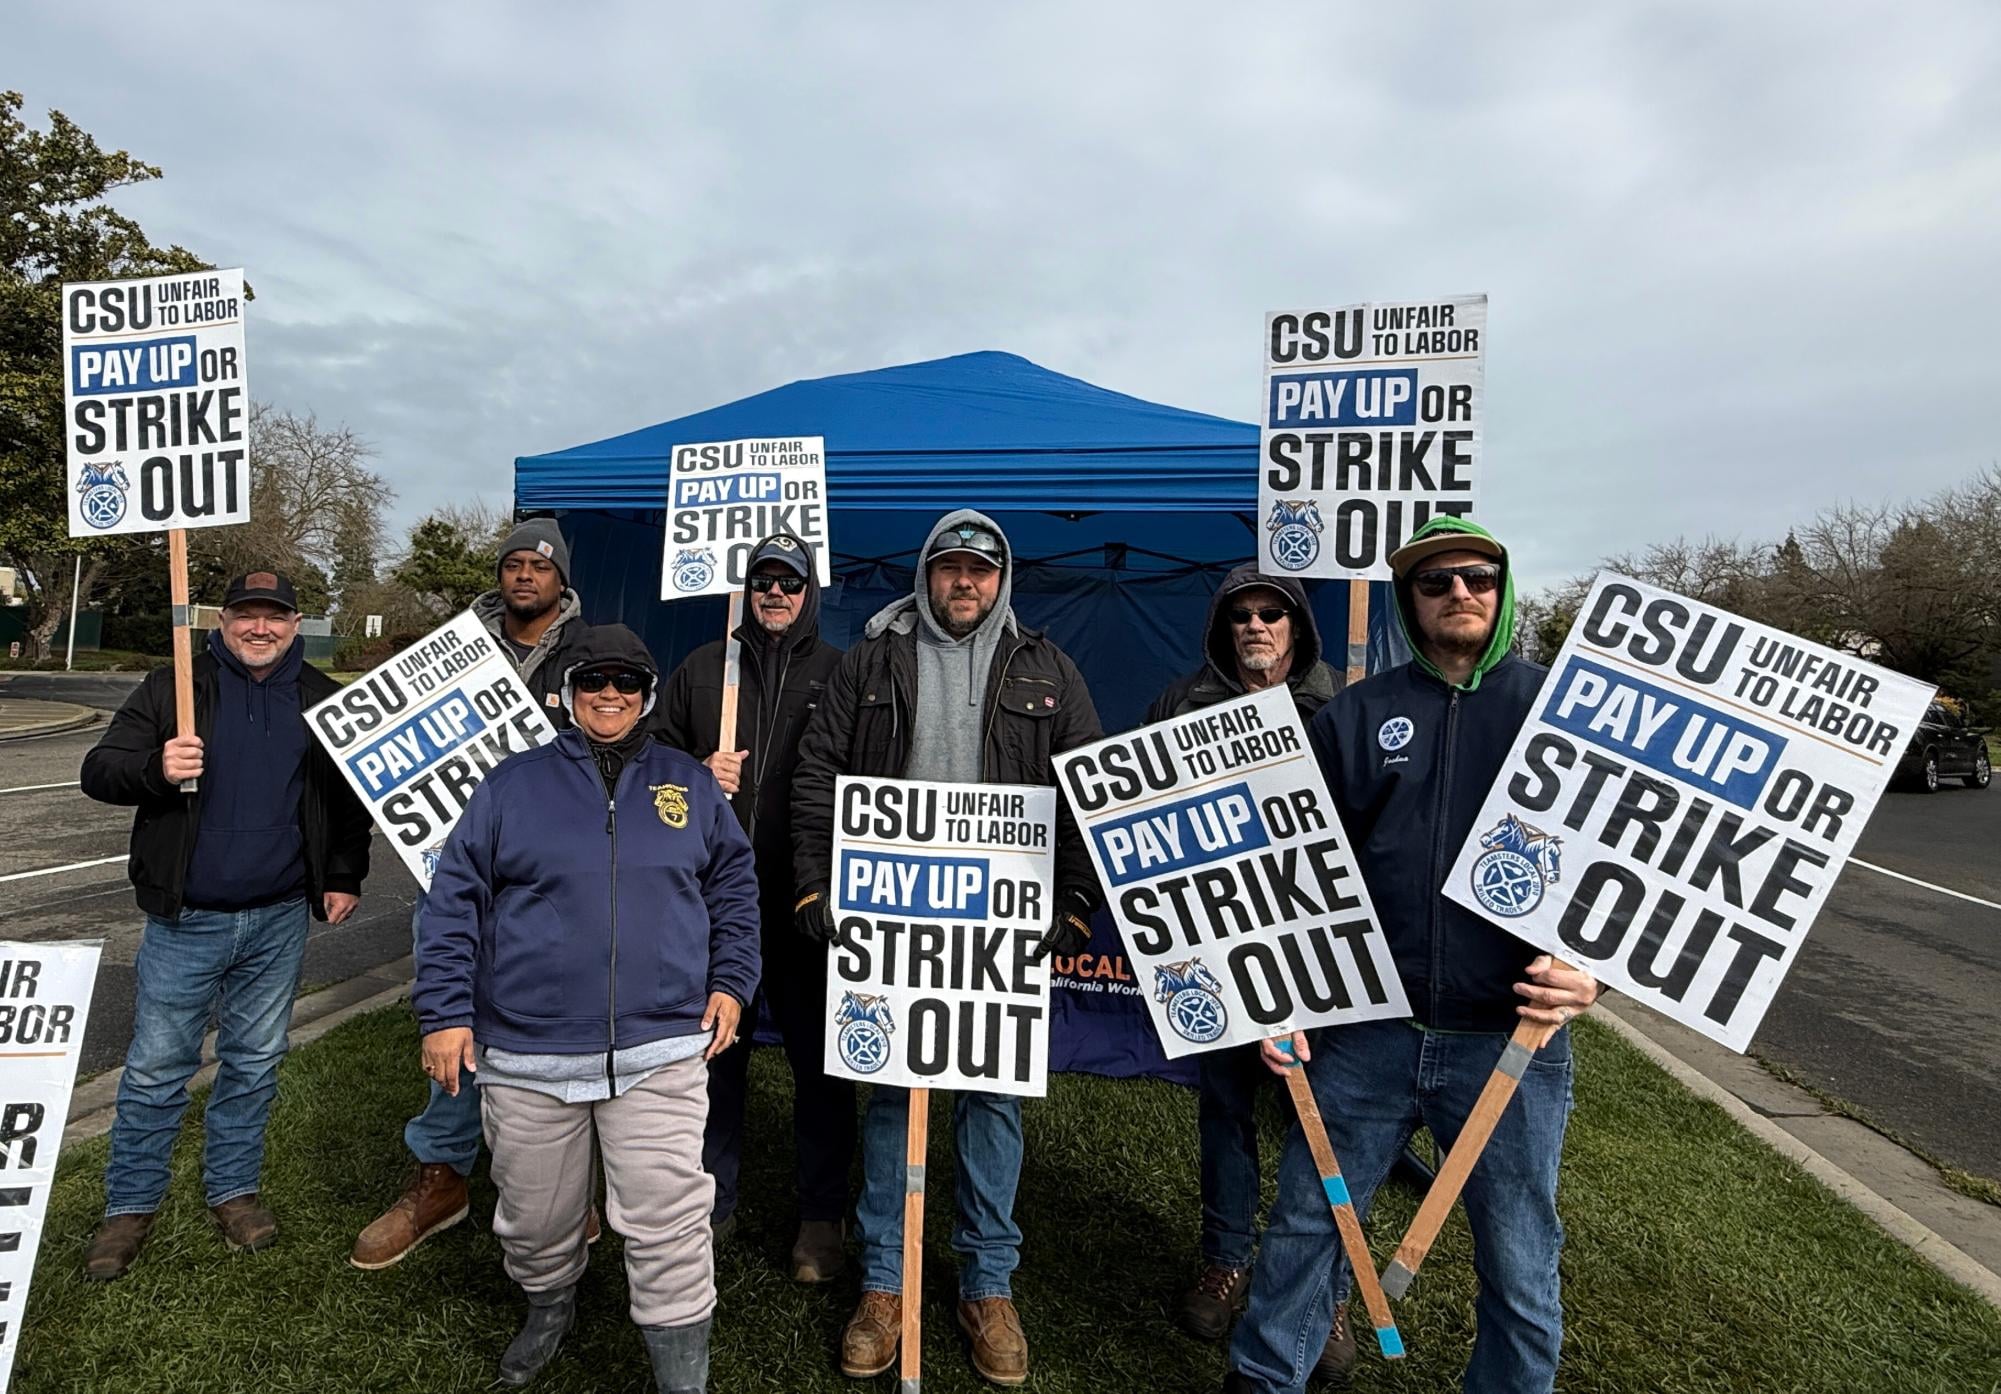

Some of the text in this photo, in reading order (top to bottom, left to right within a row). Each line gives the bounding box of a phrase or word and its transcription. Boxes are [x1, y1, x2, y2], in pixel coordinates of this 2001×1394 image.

[70, 284, 153, 333] CSU
[158, 277, 220, 303] UNFAIR
[158, 298, 238, 326] TO LABOR
[1374, 304, 1455, 331] UNFAIR
[1270, 308, 1364, 363] CSU
[1372, 329, 1479, 356] TO LABOR
[79, 343, 238, 388] PAY UP OR
[75, 387, 242, 455] STRIKE
[1277, 376, 1473, 422] PAY UP OR
[676, 443, 743, 472] CSU
[750, 441, 803, 454] UNFAIR
[750, 453, 819, 466] TO LABOR
[1267, 430, 1474, 492] STRIKE
[140, 448, 244, 521] OUT
[680, 476, 818, 504] PAY UP OR
[673, 504, 822, 544] STRIKE
[396, 629, 463, 678] UNFAIR
[1582, 583, 1745, 684] CSU
[408, 636, 492, 697] TO LABOR
[1748, 636, 1879, 708] UNFAIR
[315, 668, 408, 749] CSU
[355, 676, 523, 792] PAY UP OR
[1172, 703, 1263, 752] UNFAIR
[1734, 667, 1899, 756] TO LABOR
[1064, 730, 1179, 812] CSU
[1182, 725, 1301, 780] TO LABOR
[1556, 668, 1855, 842] PAY UP OR
[841, 782, 937, 842] CSU
[946, 791, 1025, 818] UNFAIR
[1101, 788, 1328, 876] PAY UP OR
[1508, 732, 1830, 932] STRIKE
[945, 818, 1047, 847] TO LABOR
[847, 858, 920, 907] PAY
[928, 864, 983, 910] UP
[992, 878, 1042, 920] OR
[1480, 853, 1520, 869] TEAMSTERS
[1520, 858, 1538, 878] LOCAL
[1119, 837, 1362, 956] STRIKE
[1476, 884, 1523, 914] SKILLED TRADES
[837, 916, 1043, 996] STRIKE
[1050, 953, 1131, 981] OCAL
[1557, 860, 1787, 1026] OUT
[1050, 976, 1104, 993] alifornia
[1226, 918, 1389, 1026] OUT
[0, 1004, 75, 1044] BOR
[906, 997, 1043, 1083] OUT
[0, 1102, 45, 1169] R
